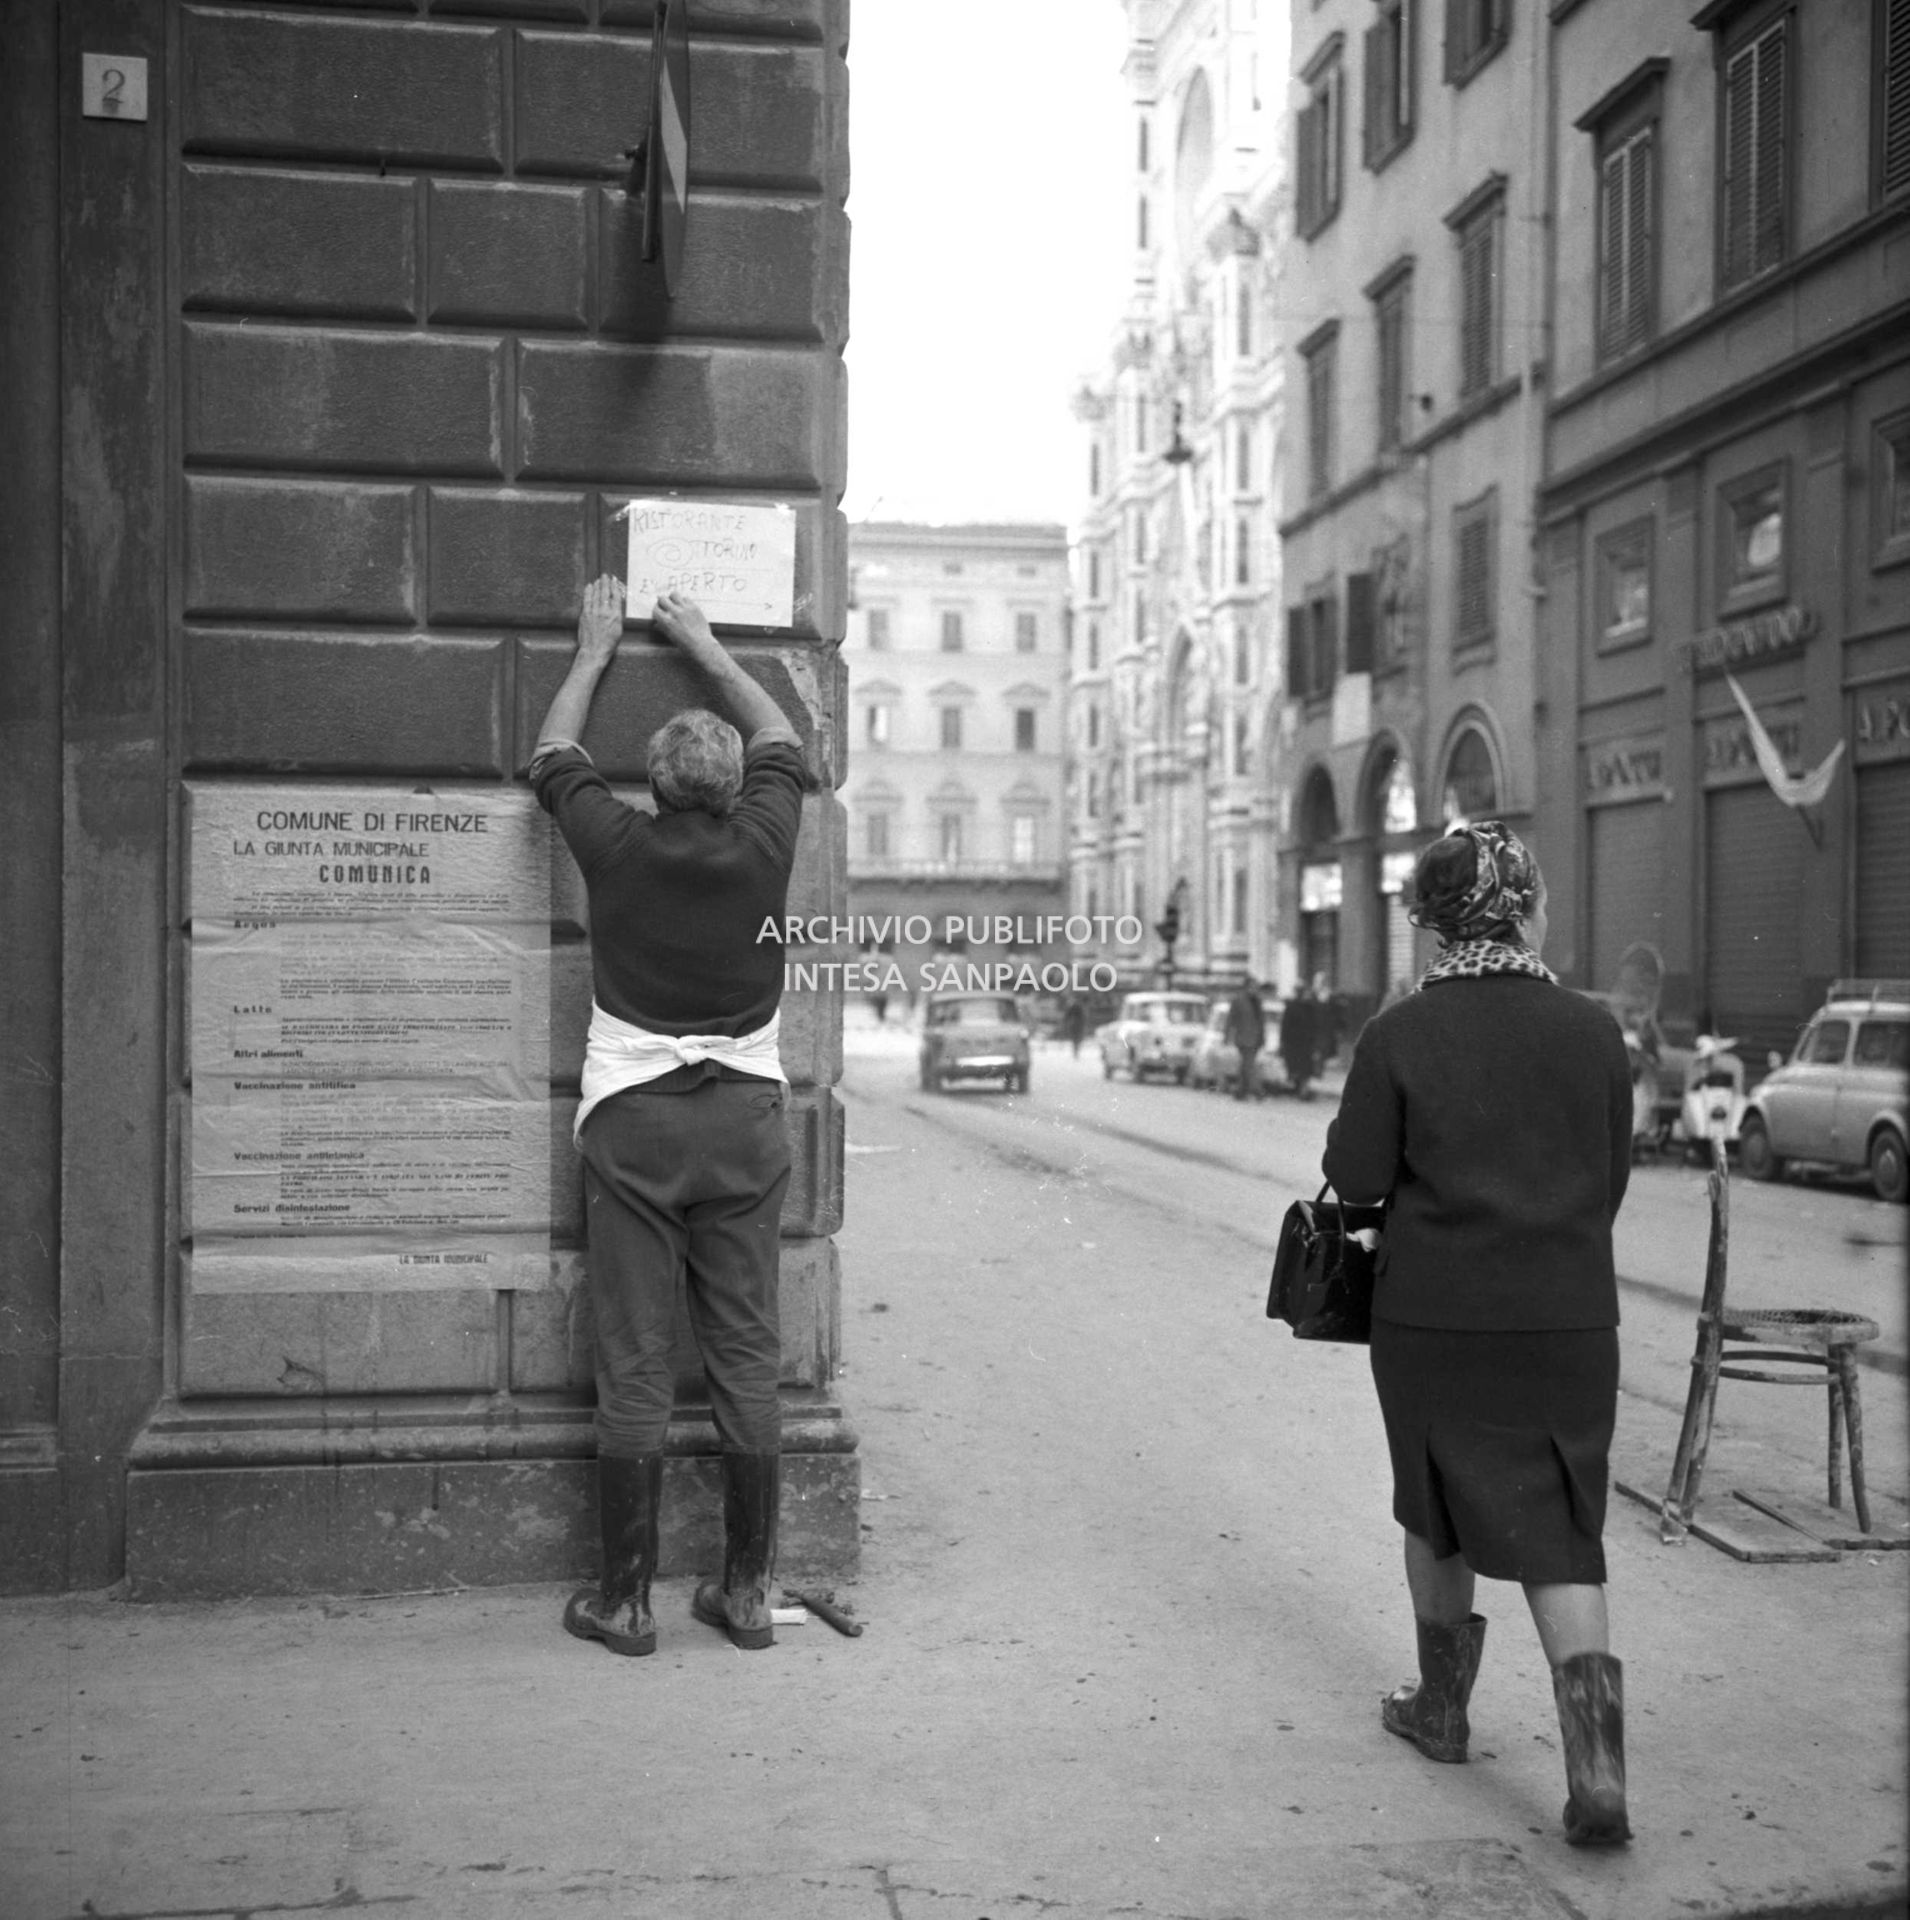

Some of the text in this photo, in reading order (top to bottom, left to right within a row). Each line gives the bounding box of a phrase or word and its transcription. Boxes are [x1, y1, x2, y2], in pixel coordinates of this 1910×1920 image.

[102, 69, 125, 104] 2
[633, 508, 747, 533] RISTORANTE
[667, 571, 748, 593] APERTO
[257, 811, 488, 833] COMUNE DI FIRENZE
[233, 841, 430, 857] LA GIUNTA MUNICIPALE
[319, 864, 431, 884] COMUNICA
[233, 1049, 304, 1059] Altri alimenti
[234, 1081, 304, 1090] Vaccinazione
[234, 1151, 301, 1161] Vaccinazione
[234, 1203, 270, 1213] Servizi
[400, 1254, 410, 1264] LA
